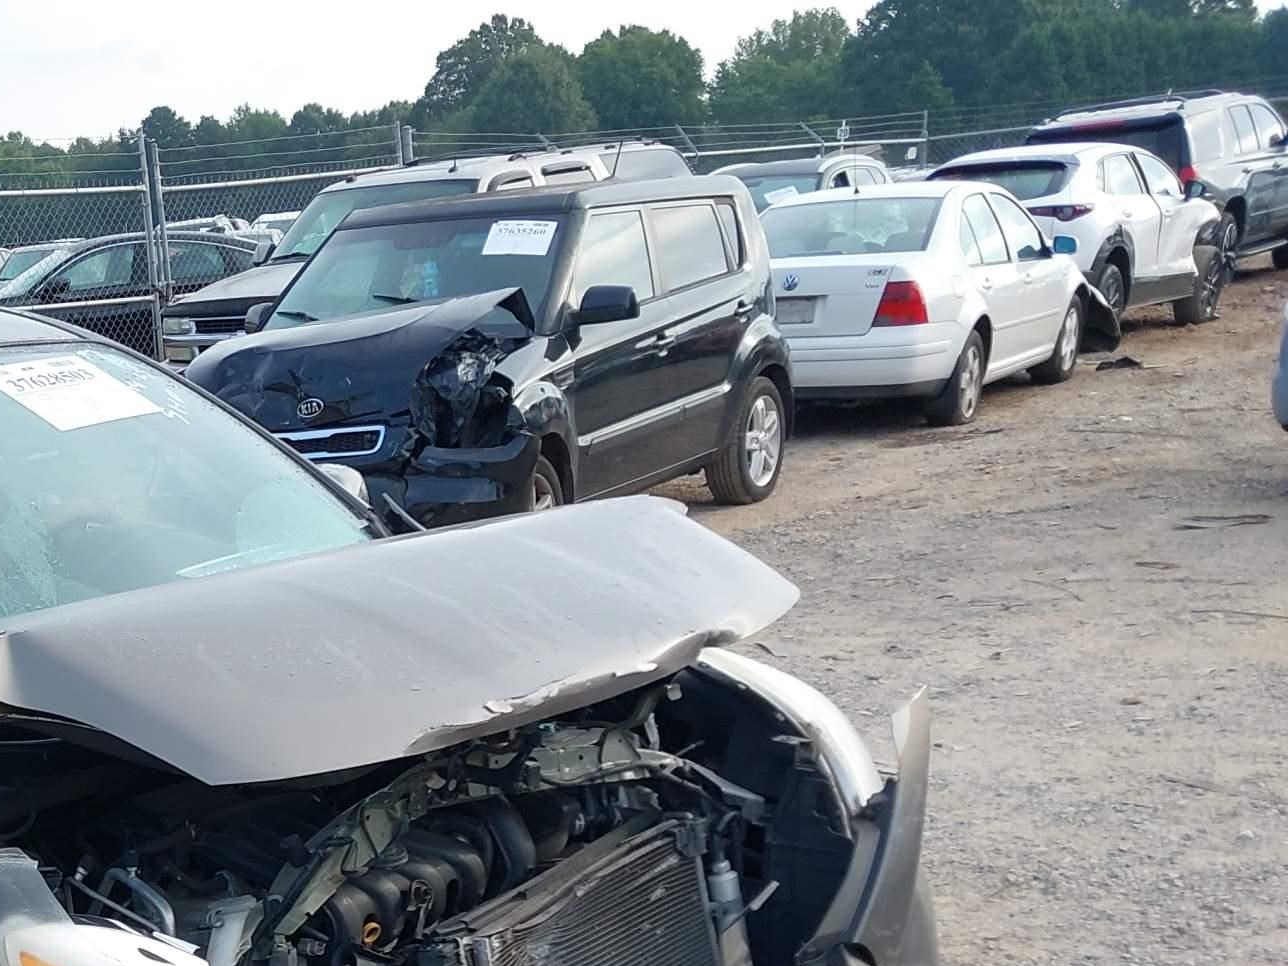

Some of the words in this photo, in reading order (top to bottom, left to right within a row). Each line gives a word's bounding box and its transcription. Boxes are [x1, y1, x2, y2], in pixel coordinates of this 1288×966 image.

[838, 129, 849, 138] 20
[497, 227, 547, 236] 37635260
[6, 368, 96, 393] 37628503
[300, 402, 320, 415] KIA
